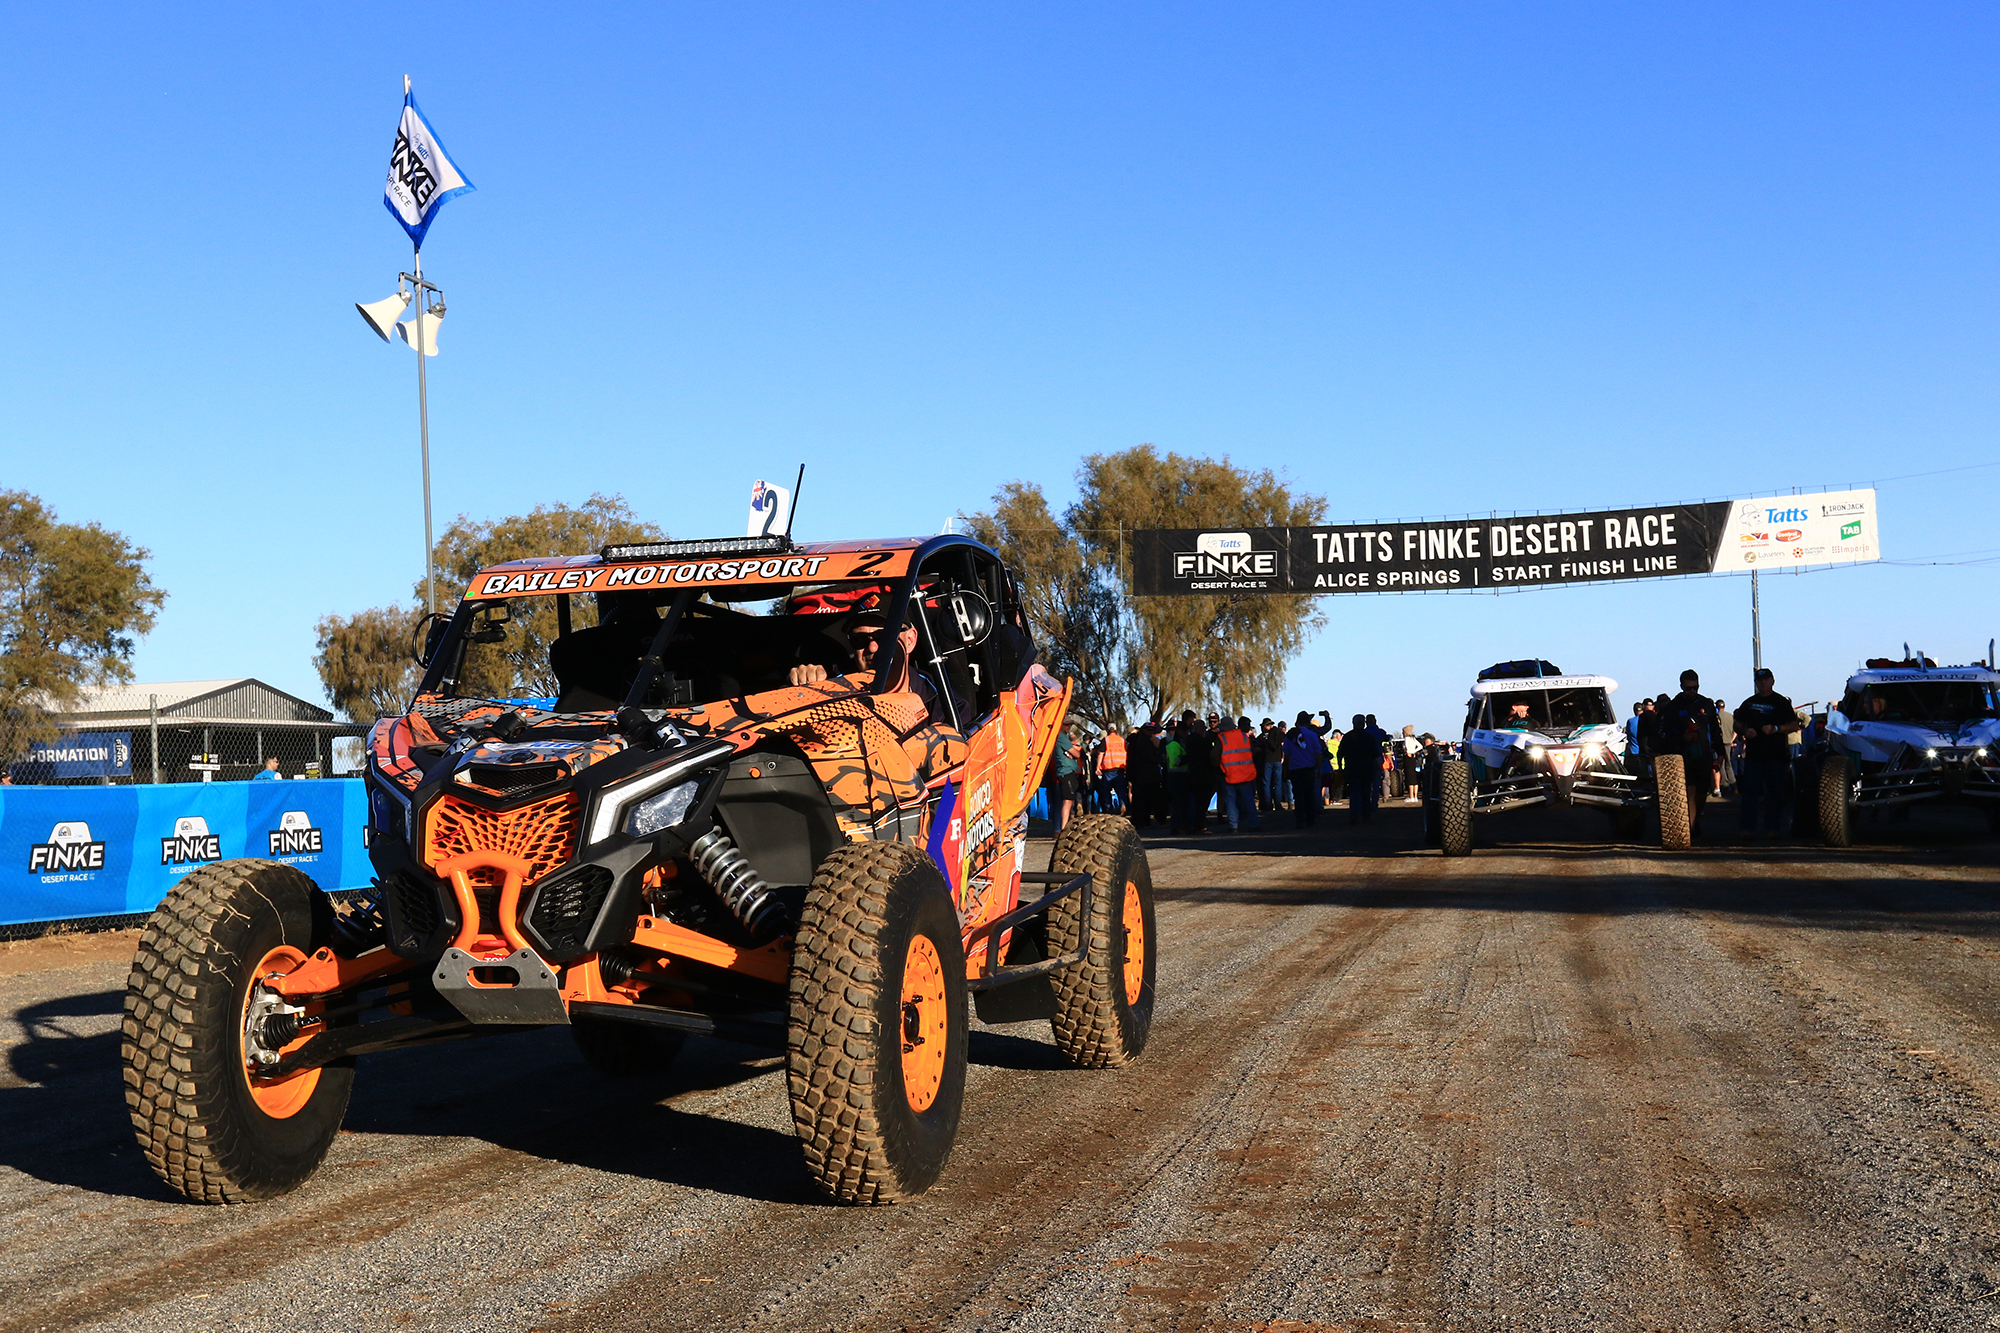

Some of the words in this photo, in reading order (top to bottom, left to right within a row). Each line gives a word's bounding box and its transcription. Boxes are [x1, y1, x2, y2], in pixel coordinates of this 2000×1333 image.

[391, 128, 437, 208] INKE
[393, 185, 412, 207] RACE
[762, 490, 778, 537] 2
[1765, 508, 1808, 523] Tatts
[1312, 531, 1393, 564] TATTS
[1404, 528, 1481, 561] FINKE
[1491, 520, 1594, 557] DESERT
[1604, 513, 1677, 550] RACE
[1842, 526, 1860, 535] TAB
[1219, 539, 1241, 548] Tatts
[482, 568, 606, 595] BAILEY
[607, 556, 829, 587] MOTORSPORT
[845, 552, 895, 577] 2
[1176, 553, 1275, 577] FINKE
[1492, 564, 1553, 582] START
[1560, 559, 1625, 577] FINISH
[1633, 555, 1678, 572] LINE
[1314, 572, 1370, 588] ALICE
[1376, 569, 1461, 586] SPRINGS
[1501, 679, 1591, 690] HOWELLS
[20, 747, 109, 763] NFORMATION
[162, 837, 220, 863] FINKE
[269, 830, 322, 854] FINKE
[30, 843, 104, 872] FINKE
[169, 865, 193, 874] DESERT
[41, 874, 68, 883] DESERT
[69, 873, 88, 882] RACE
